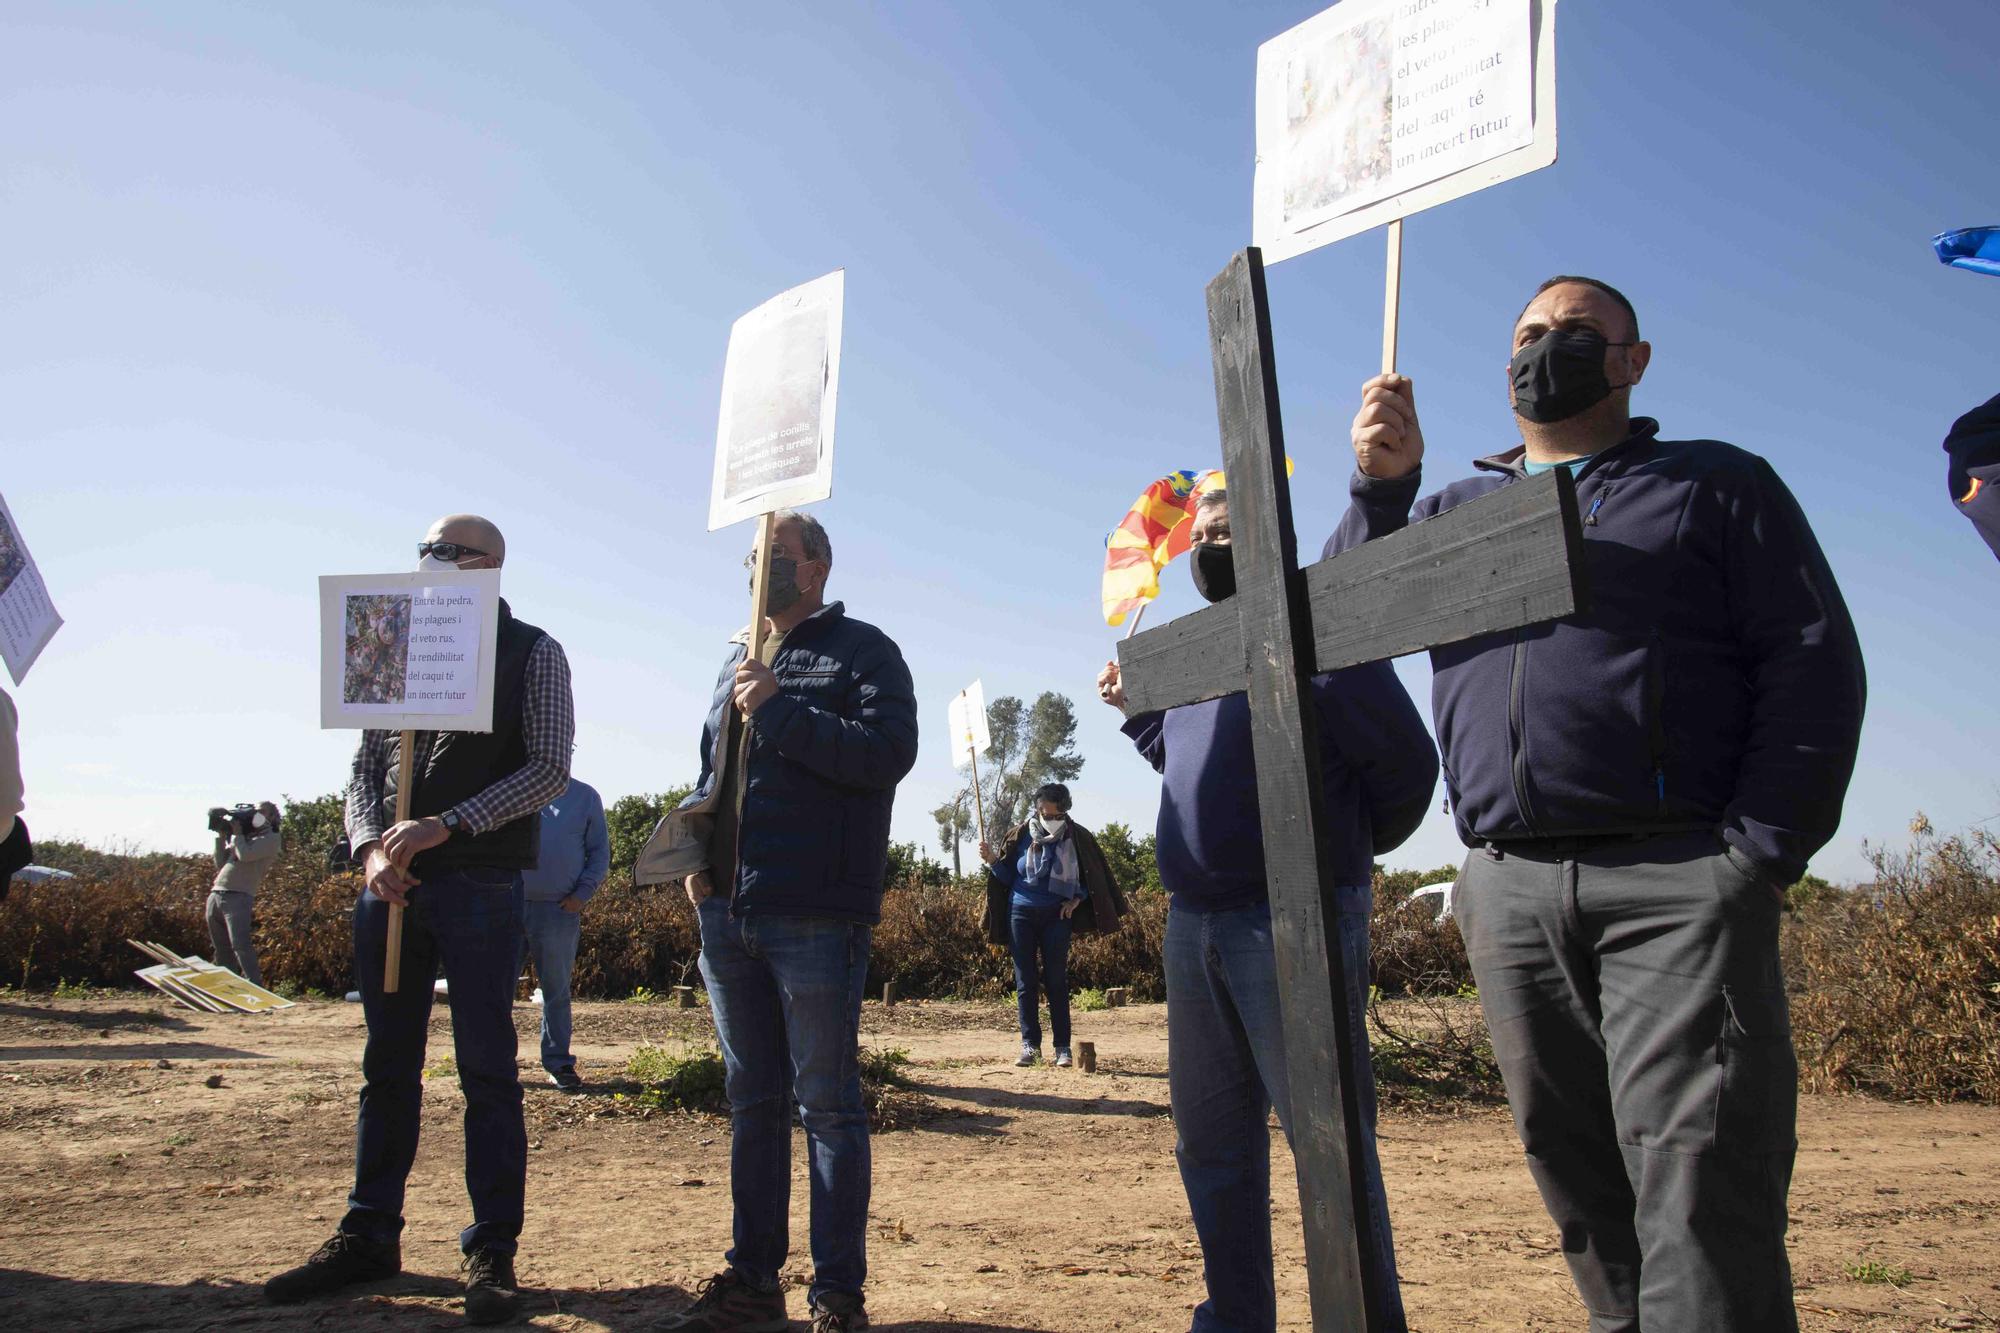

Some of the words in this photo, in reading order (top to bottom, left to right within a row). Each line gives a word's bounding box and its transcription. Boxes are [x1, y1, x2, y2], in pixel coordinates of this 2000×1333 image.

[1399, 0, 1438, 19] Entr
[1398, 32, 1418, 50] les
[1397, 61, 1410, 79] el
[1414, 49, 1447, 71] veto
[1397, 95, 1410, 109] la
[1396, 117, 1419, 138] del
[1469, 89, 1484, 108] té
[1396, 153, 1415, 169] un
[1419, 131, 1465, 161] incert
[1470, 114, 1512, 140] futur
[780, 423, 810, 438] conills
[414, 597, 435, 606] Entre
[437, 595, 445, 606] la
[446, 595, 474, 607] pedra,
[412, 615, 423, 625] les
[424, 614, 457, 627] plagues
[410, 633, 418, 643] el
[419, 635, 438, 643] veto
[439, 635, 456, 644] rus,
[409, 652, 417, 662] la
[418, 651, 464, 662] rendibilitat
[408, 671, 420, 681] del
[421, 671, 444, 683] caqui
[446, 670, 455, 681] té
[418, 690, 443, 700] incert
[444, 690, 467, 700] futur
